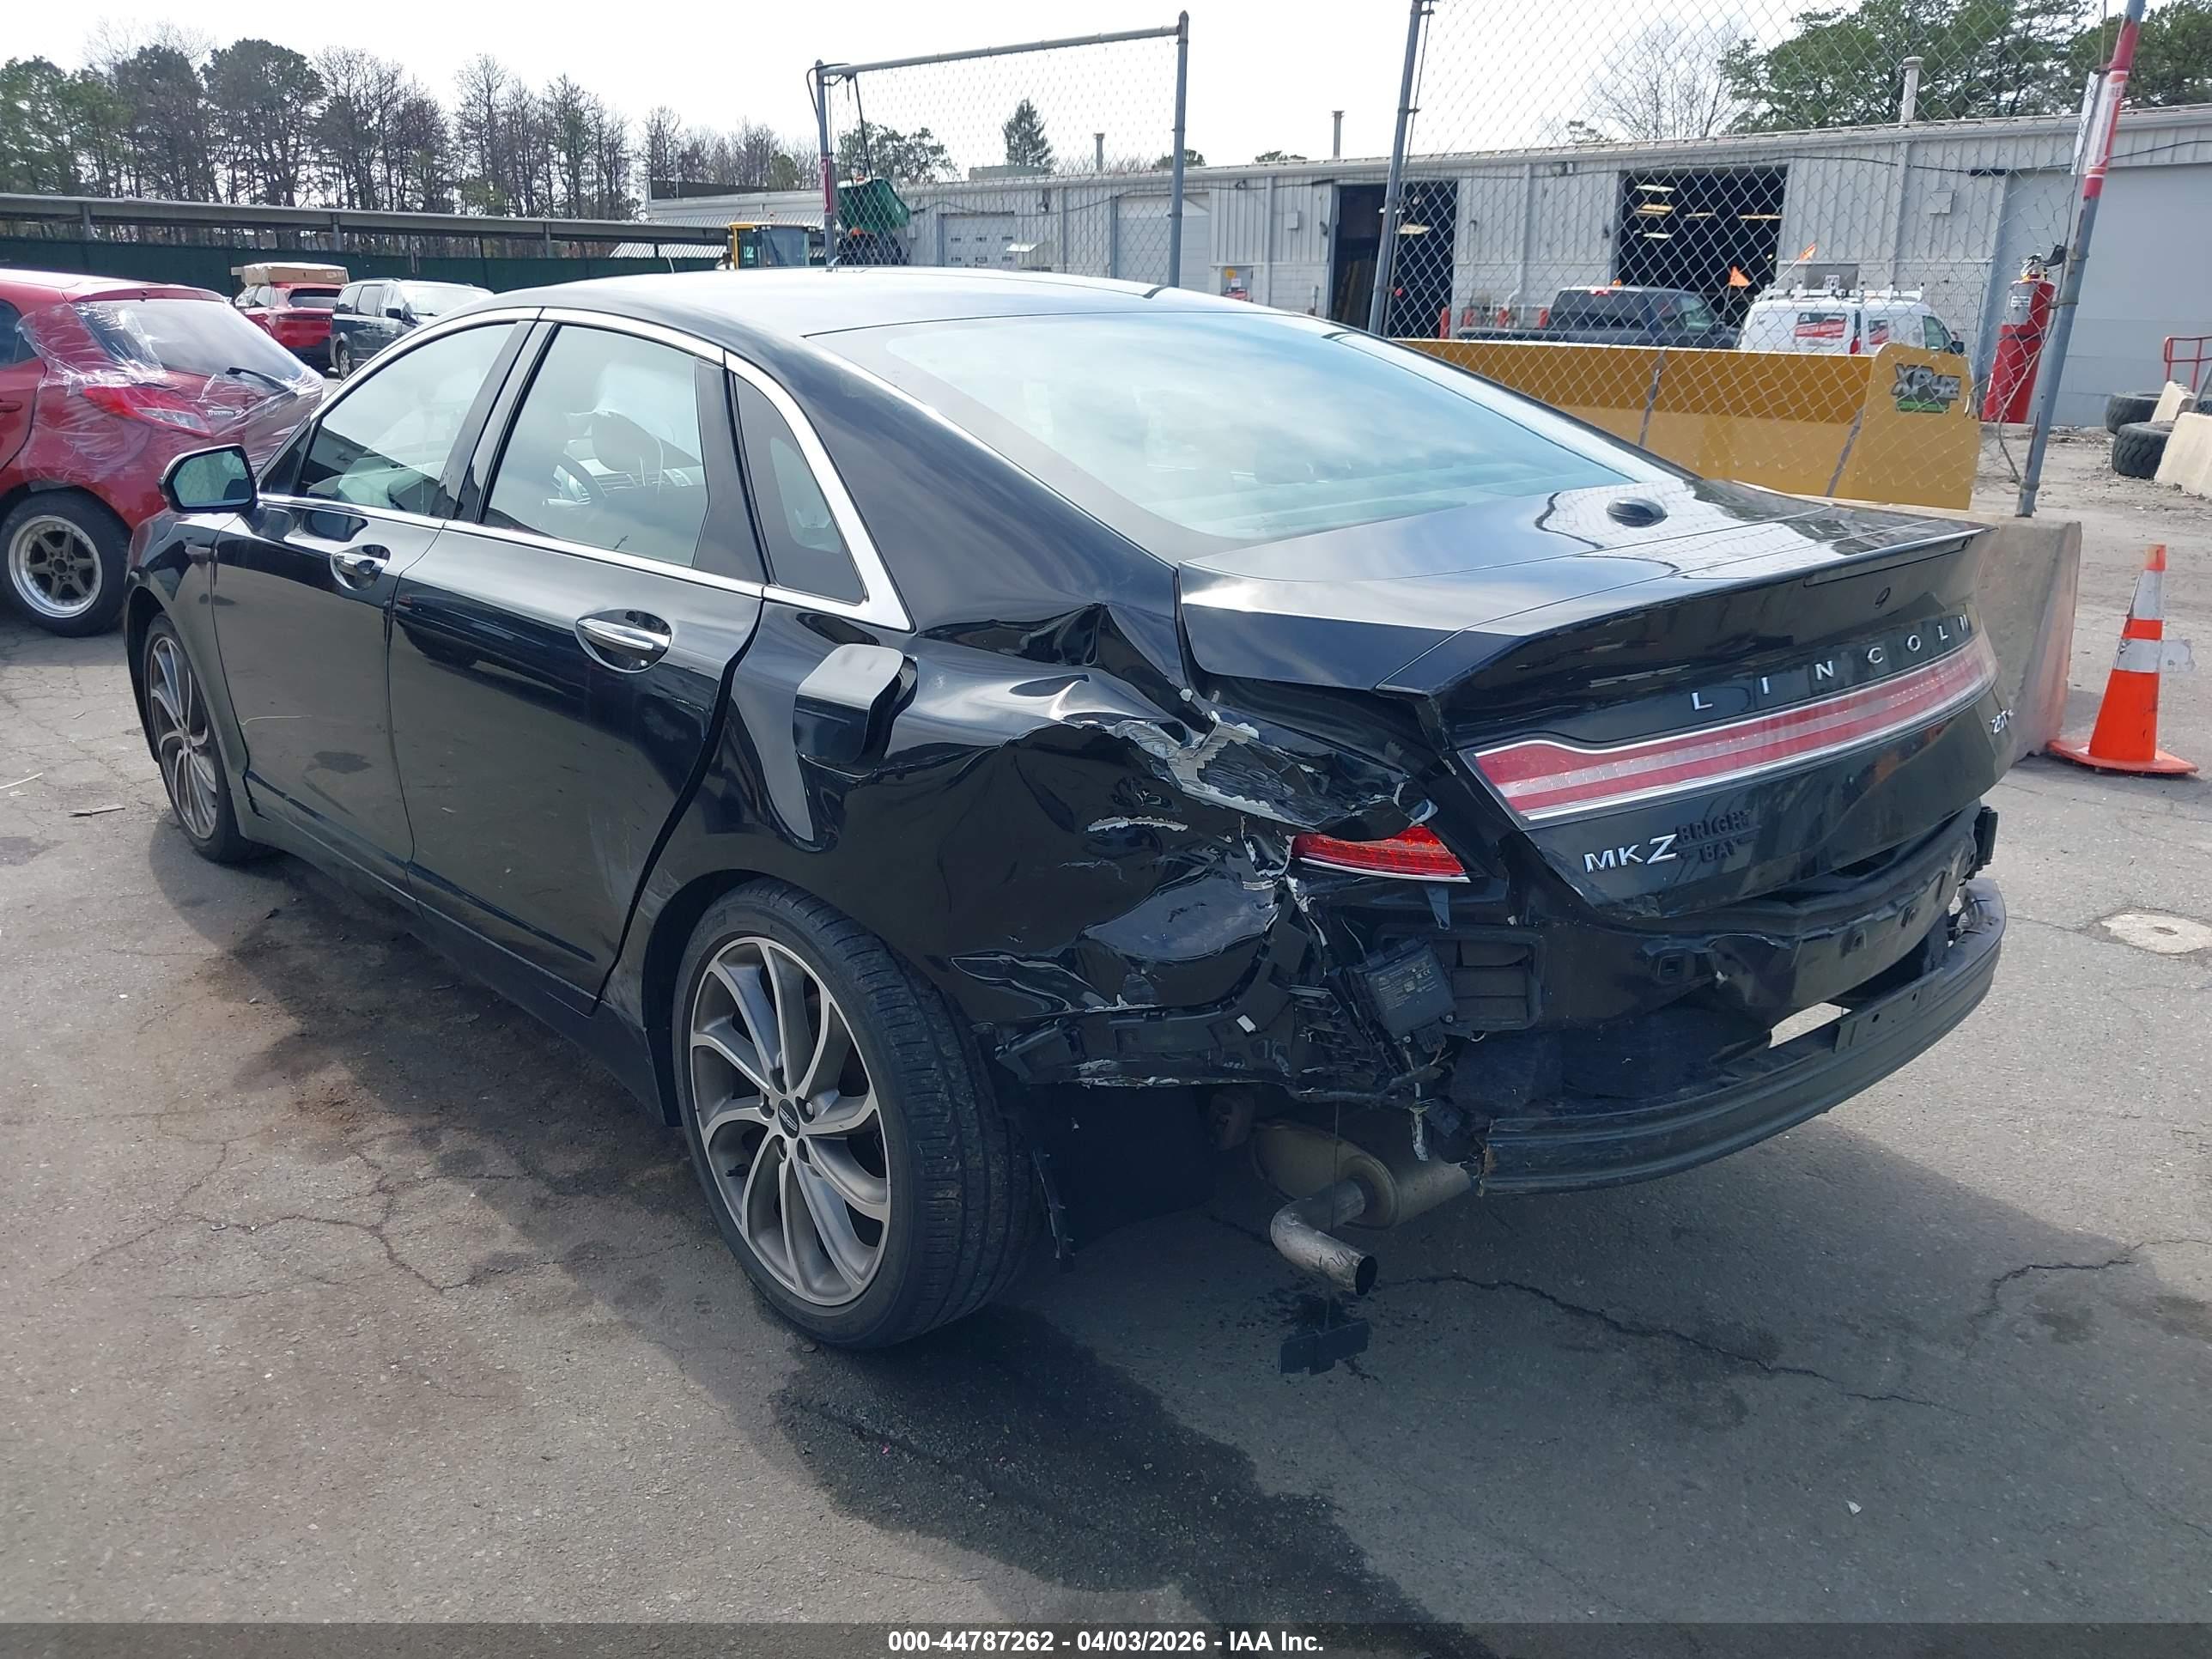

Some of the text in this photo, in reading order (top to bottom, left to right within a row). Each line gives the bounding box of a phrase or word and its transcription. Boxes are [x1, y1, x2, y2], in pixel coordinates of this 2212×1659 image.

[1691, 614, 1970, 711] LINCOLN
[1583, 833, 1679, 874] MKZ
[1700, 839, 1743, 864] BAY
